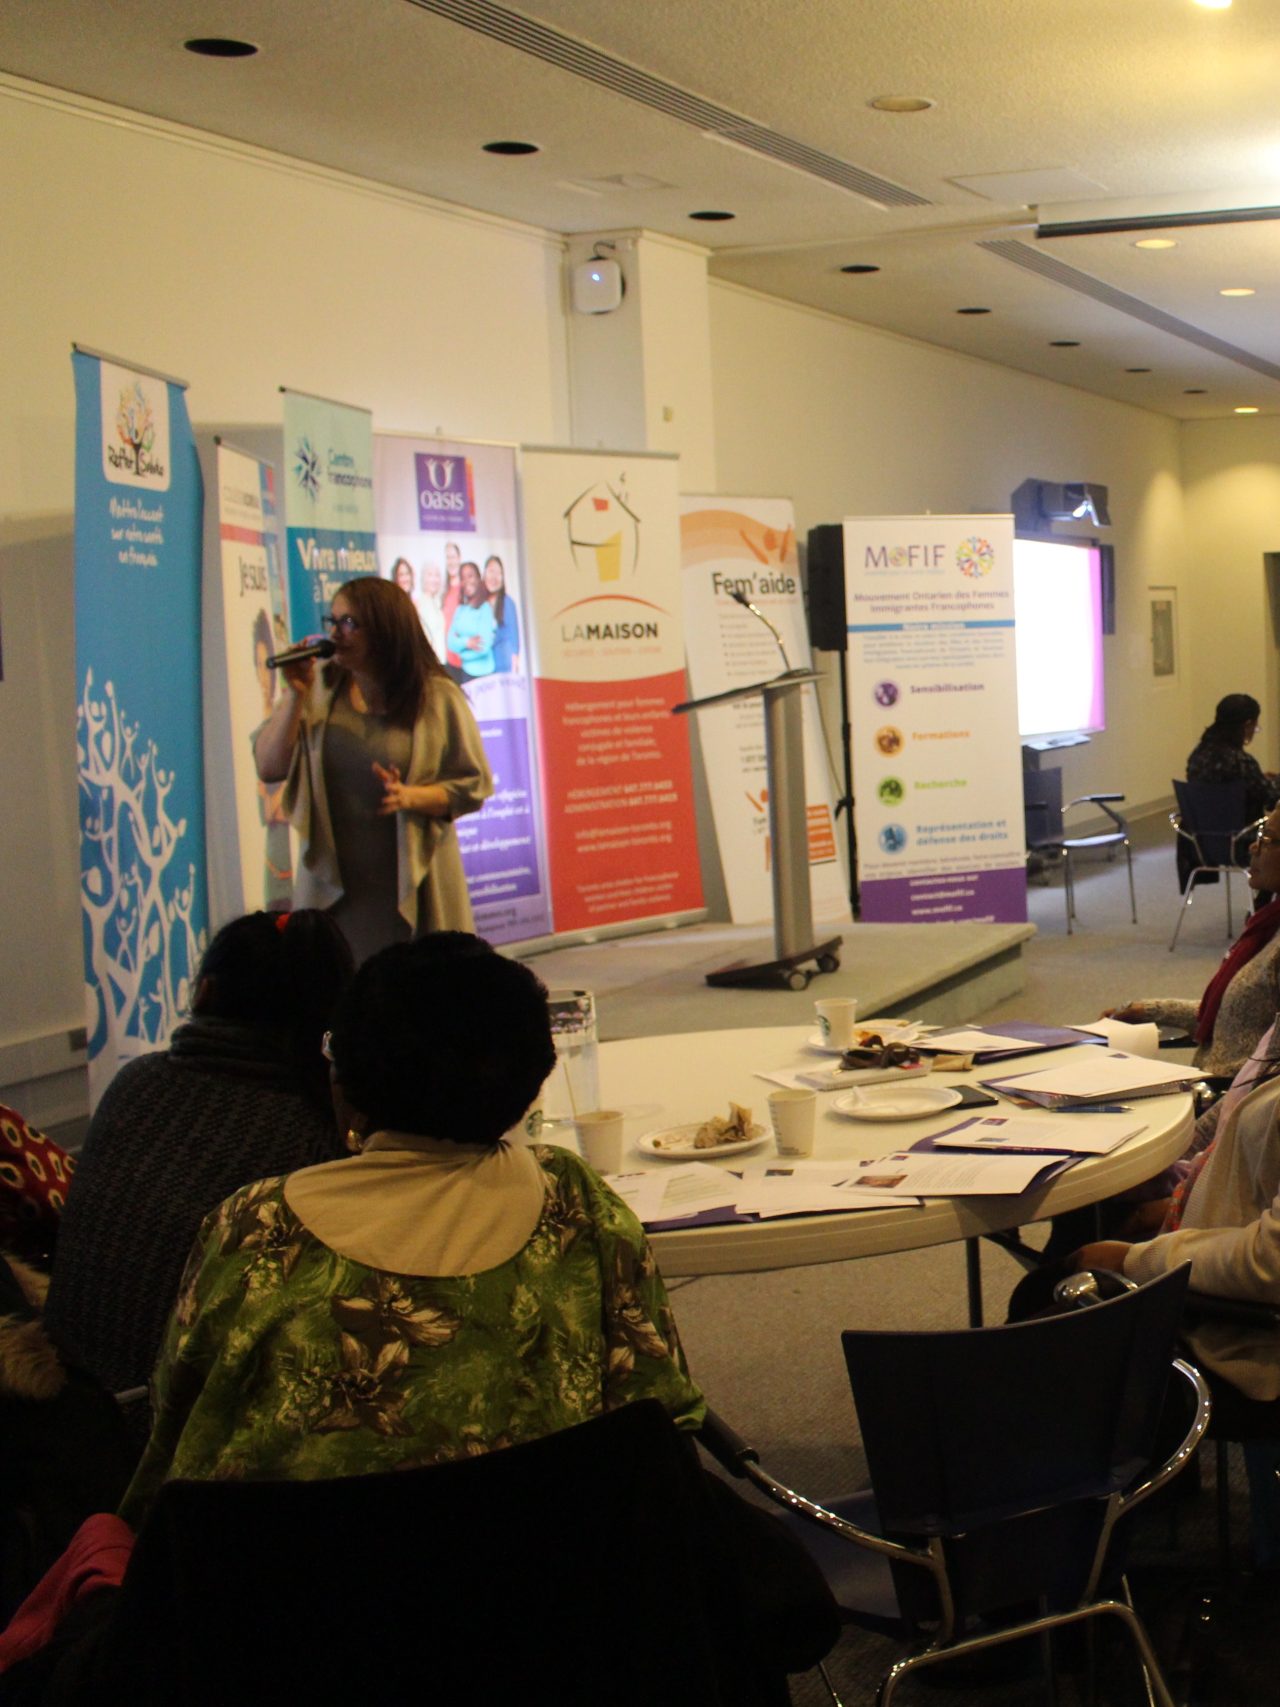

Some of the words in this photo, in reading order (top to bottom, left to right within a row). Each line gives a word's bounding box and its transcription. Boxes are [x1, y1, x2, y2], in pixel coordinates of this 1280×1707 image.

[421, 489, 464, 511] oasis
[296, 537, 335, 571] Vivre
[712, 572, 796, 596] Fem'aide
[910, 682, 984, 694] Sensibilisation
[912, 730, 970, 741] Formations
[915, 778, 967, 790] Recherche
[979, 831, 1009, 842] droits
